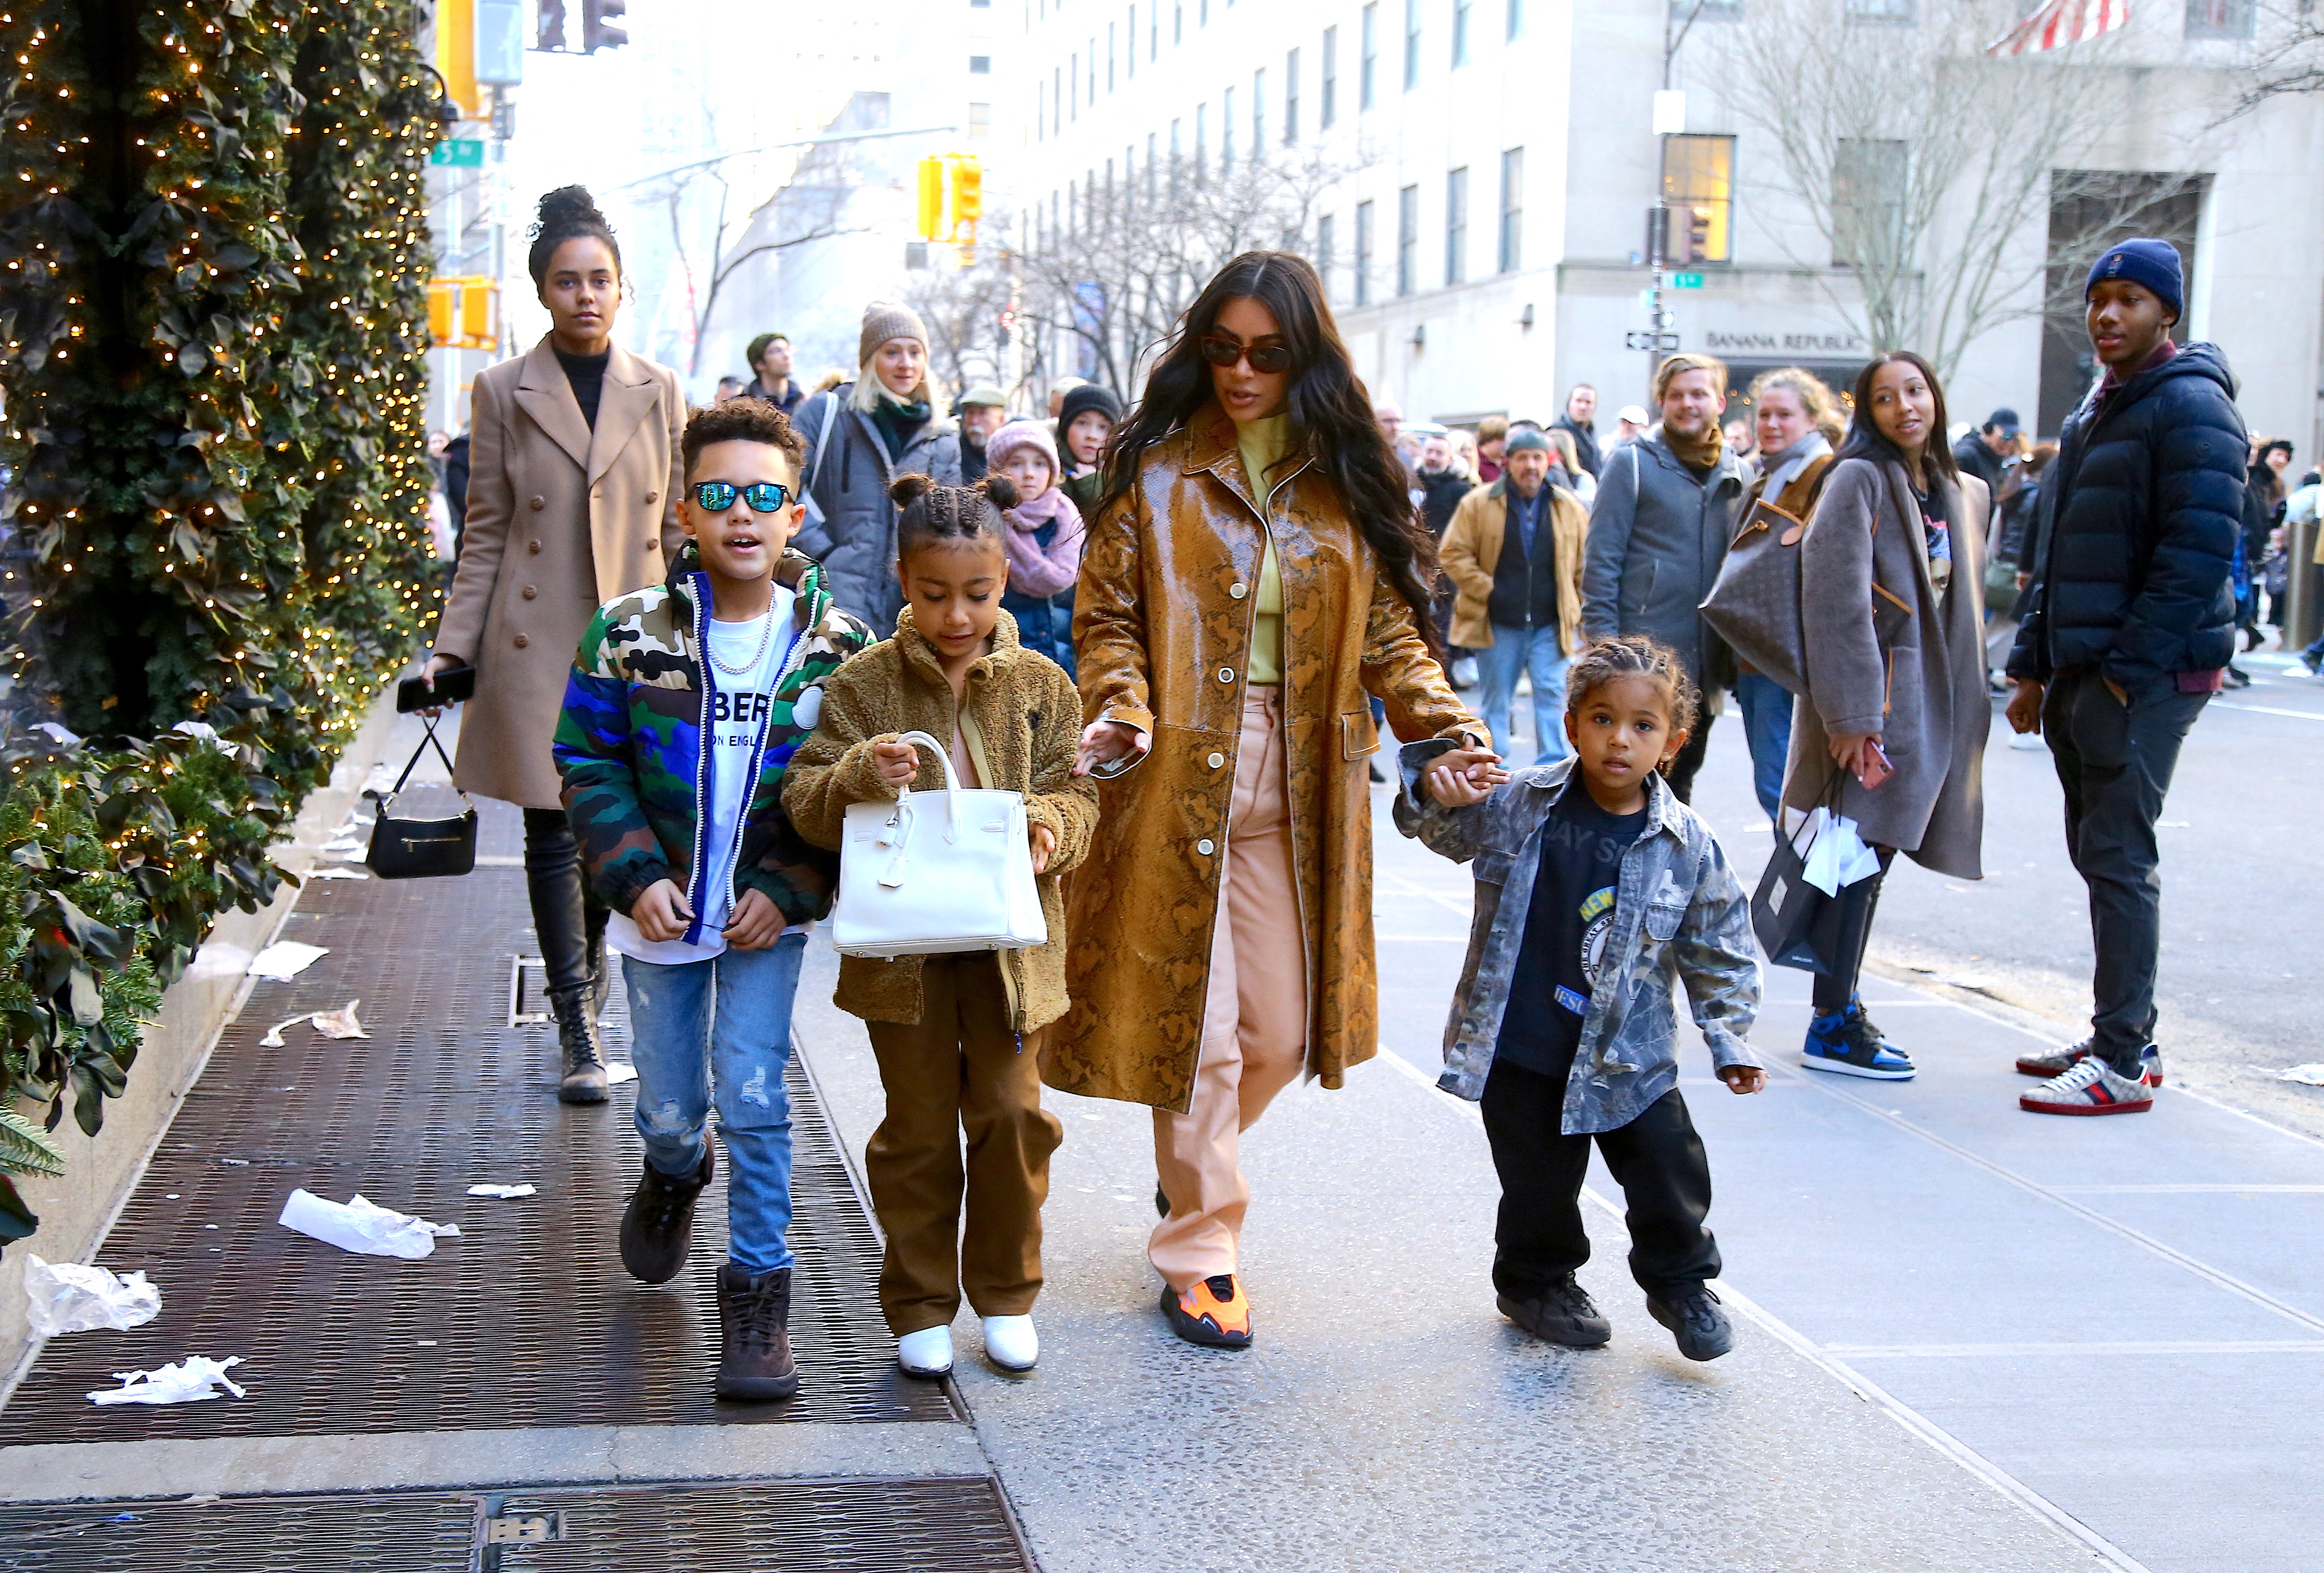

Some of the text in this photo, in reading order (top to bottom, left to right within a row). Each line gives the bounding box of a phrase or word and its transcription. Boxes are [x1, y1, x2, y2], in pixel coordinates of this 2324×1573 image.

[440, 140, 453, 164] 5
[1706, 330, 1864, 352] BANANA REPUBLIC
